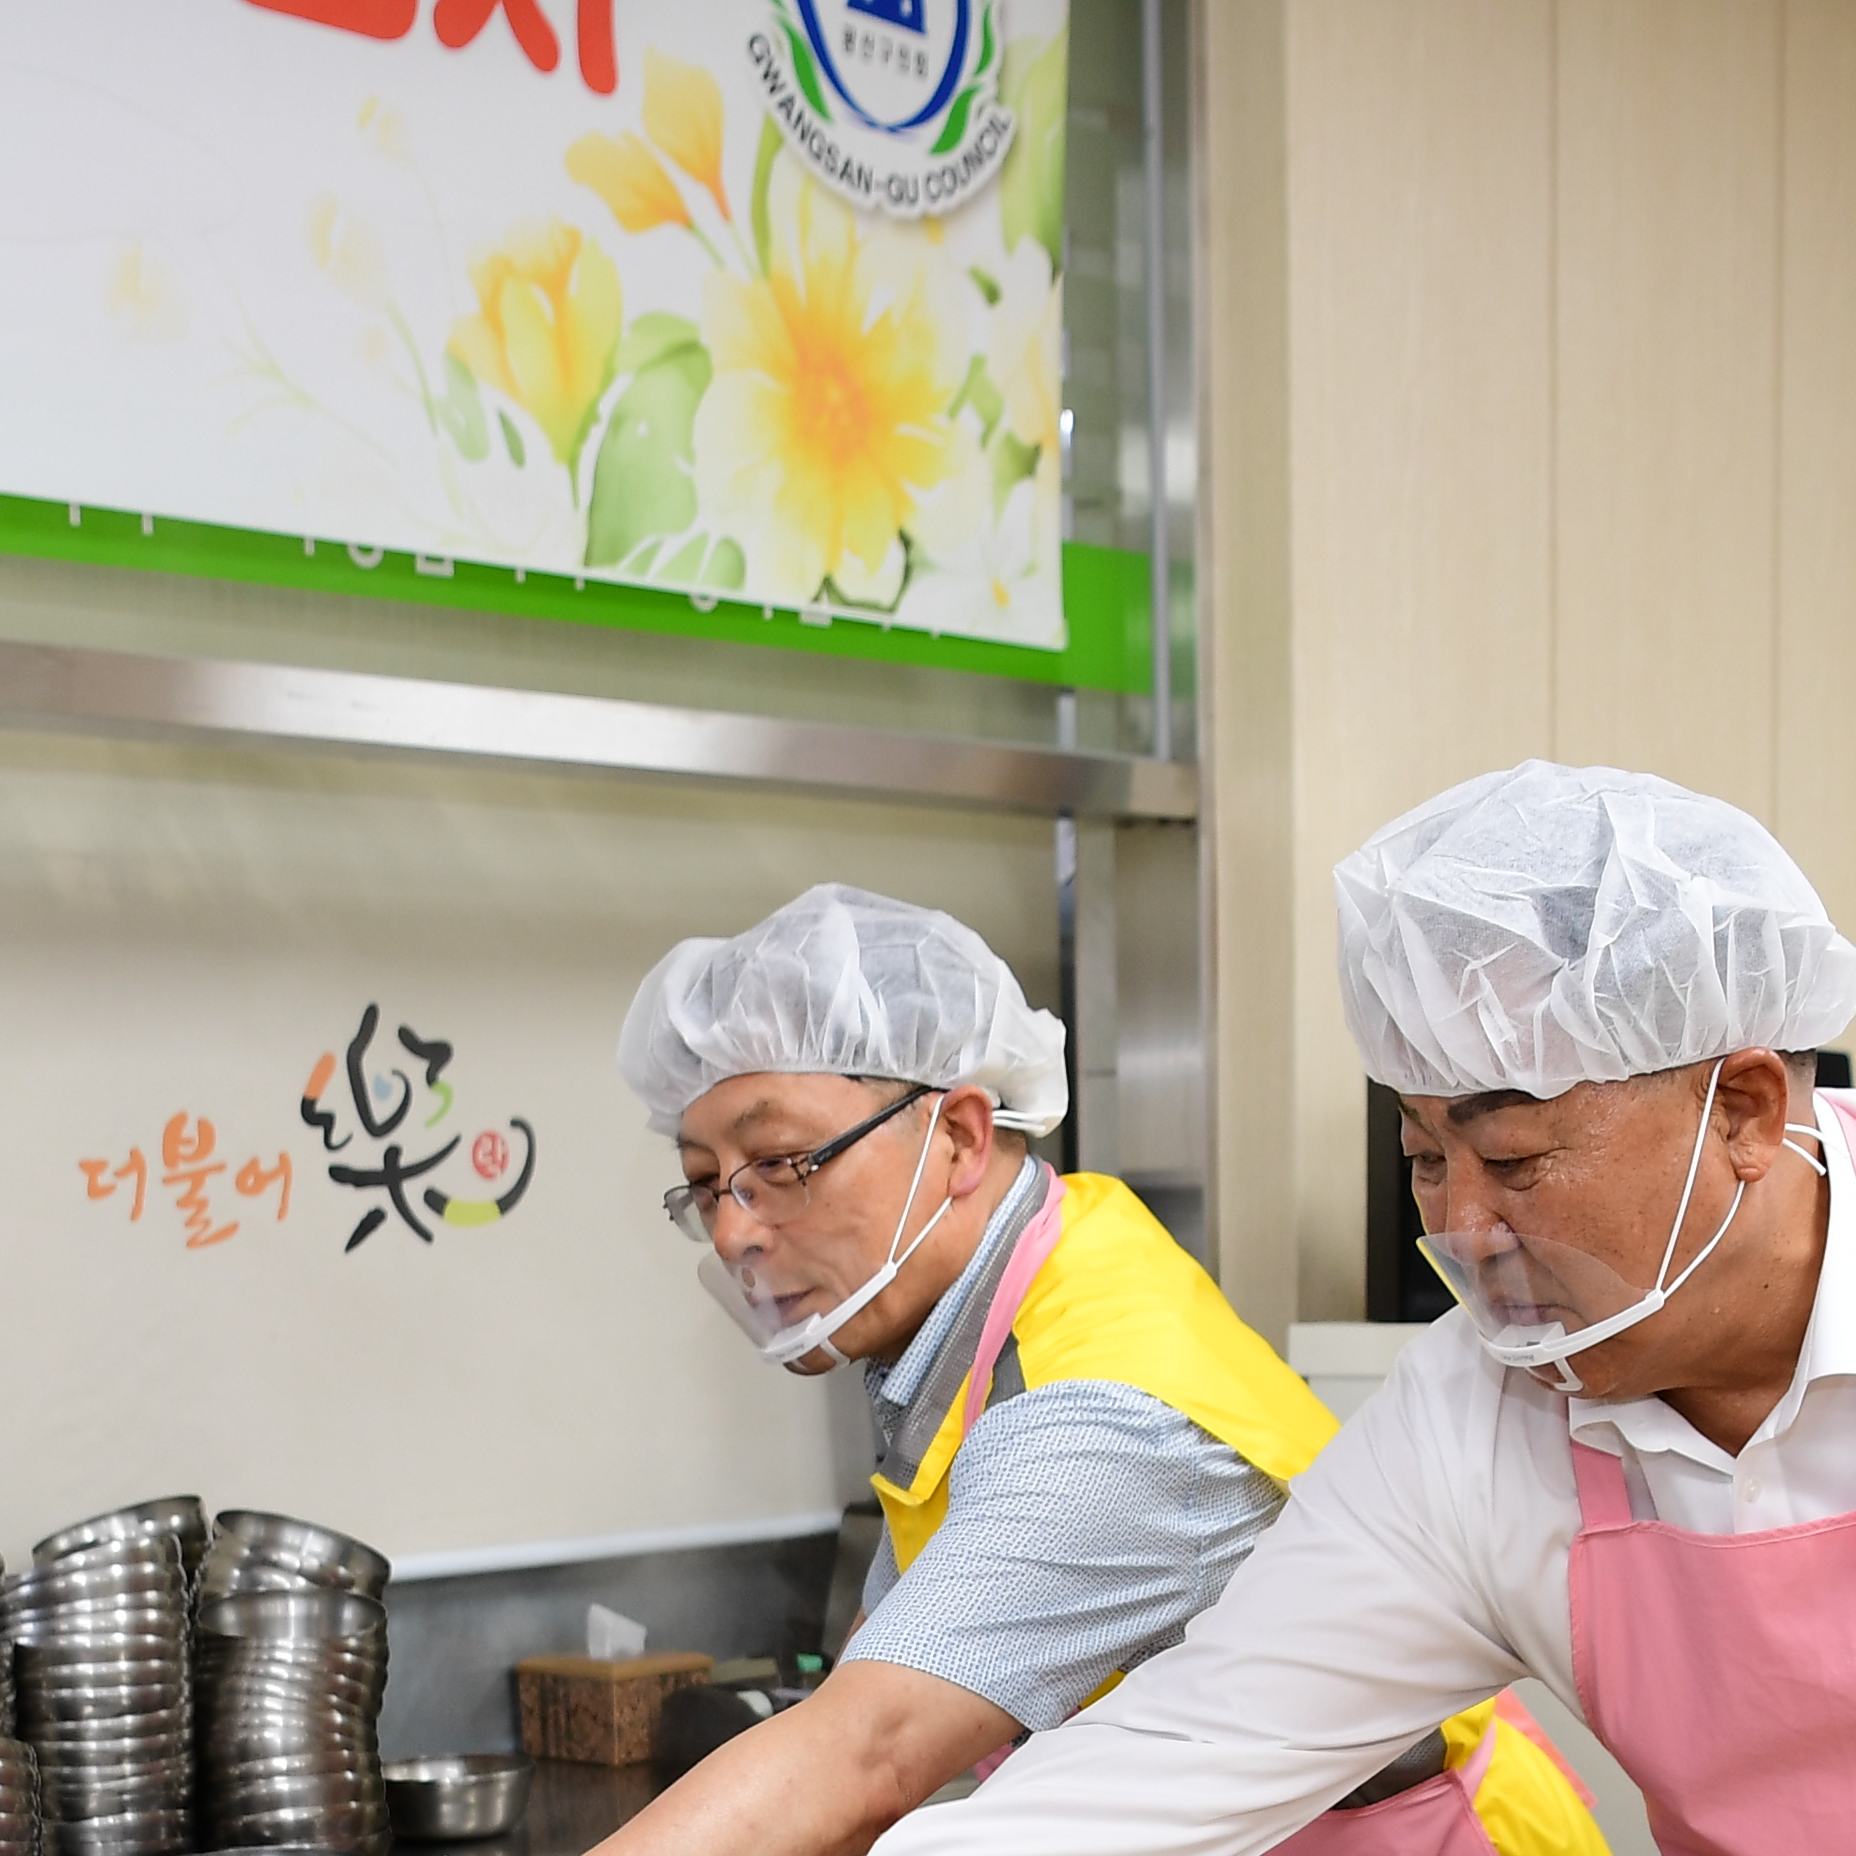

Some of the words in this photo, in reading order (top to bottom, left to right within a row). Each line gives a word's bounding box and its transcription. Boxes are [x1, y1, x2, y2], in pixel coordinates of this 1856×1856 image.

[748, 33, 920, 205] GWANGSAN-GU
[925, 112, 1012, 204] COUNCIL
[78, 1109, 294, 1250] 더불어
